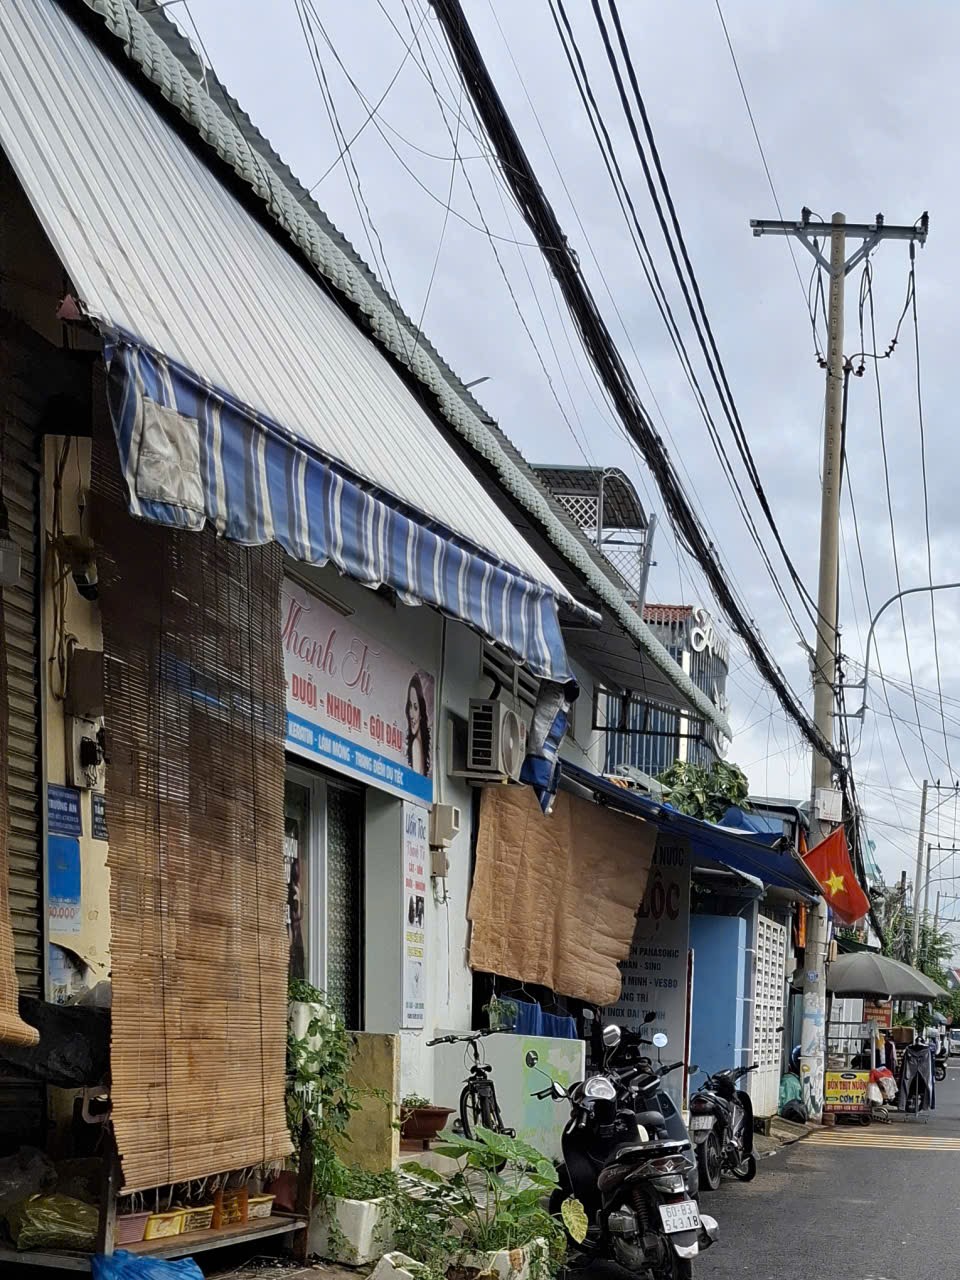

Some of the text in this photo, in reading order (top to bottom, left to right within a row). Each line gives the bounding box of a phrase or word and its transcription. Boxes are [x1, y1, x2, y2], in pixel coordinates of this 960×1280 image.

[280, 591, 337, 679] Thanh
[326, 692, 361, 733] NHUỘM
[640, 947, 680, 958] PANASONIC
[607, 1007, 625, 1018] INOX
[666, 1204, 692, 1218] 60-B3
[665, 1215, 698, 1231] 543.18
